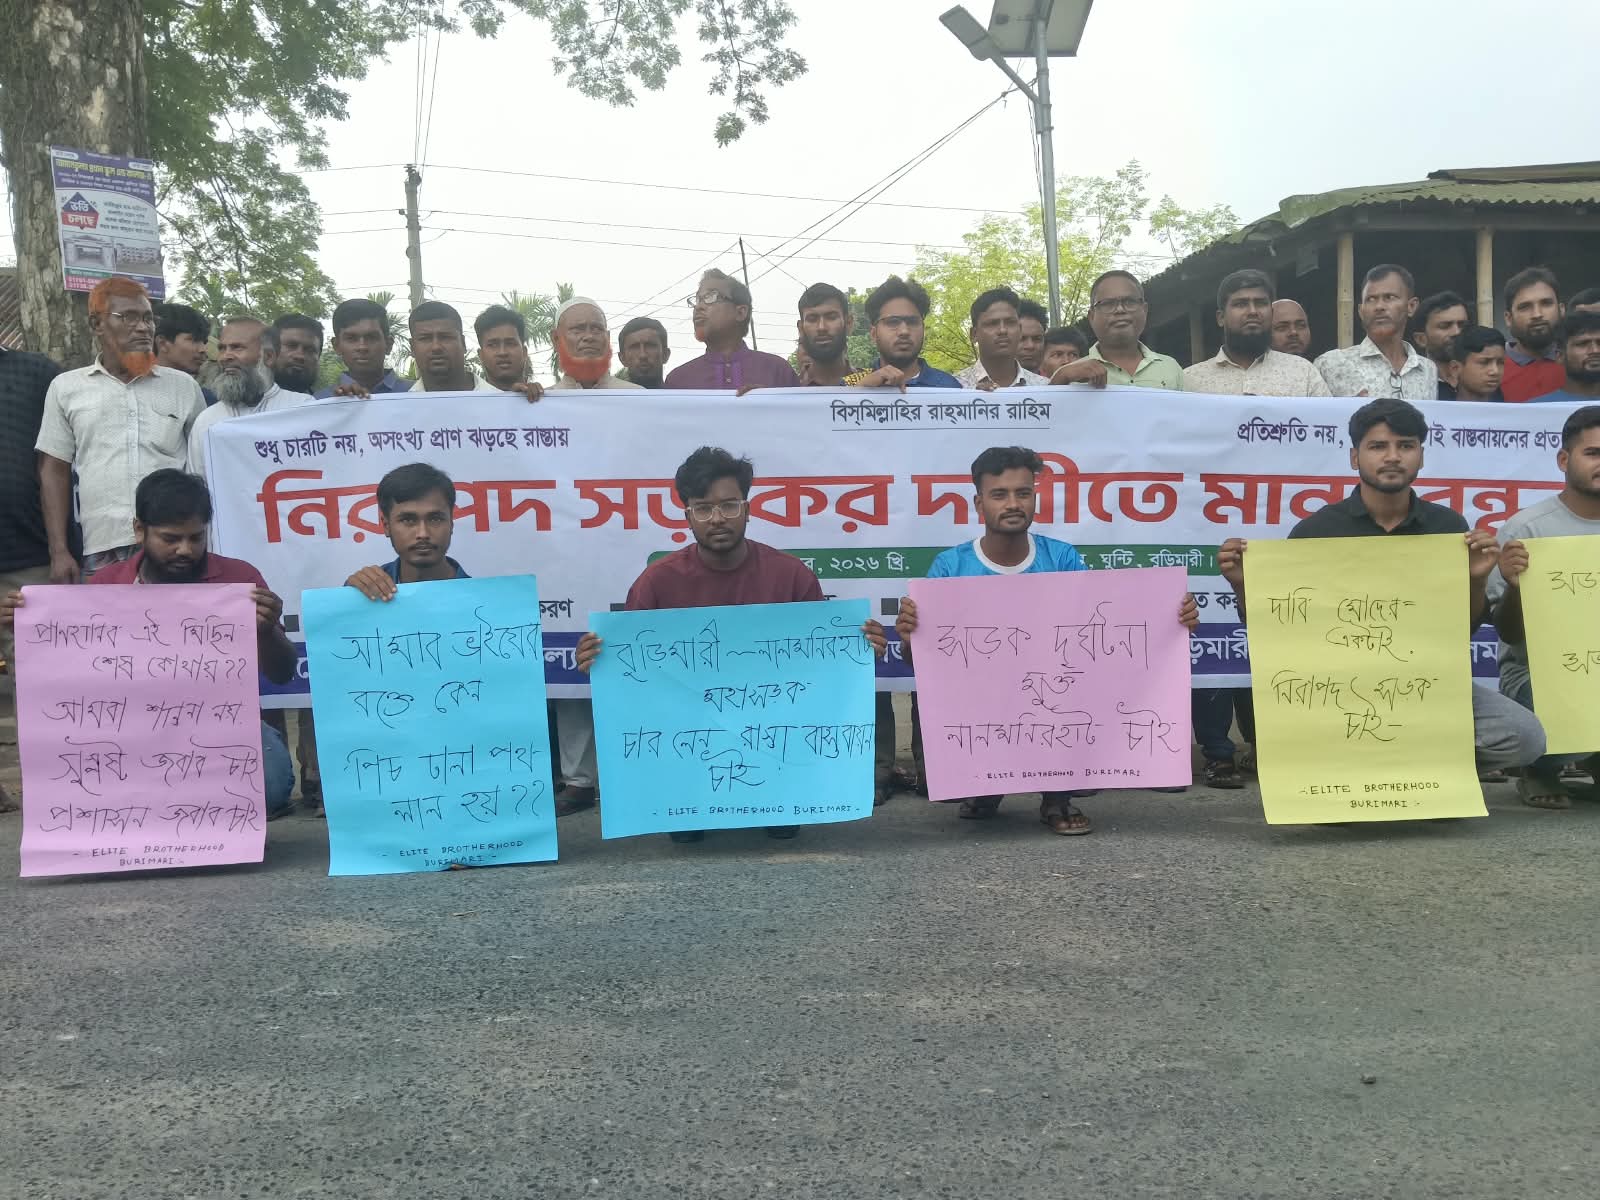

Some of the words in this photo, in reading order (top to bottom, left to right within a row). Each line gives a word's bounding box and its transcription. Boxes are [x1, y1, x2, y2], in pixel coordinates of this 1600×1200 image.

[67, 214, 95, 226] চলছে
[1006, 398, 1052, 423] রাহিম
[1237, 417, 1307, 445] প্রতিশ্রুতি
[1314, 425, 1344, 449] নয়,
[1451, 427, 1530, 449] বাস্তবায়নের
[254, 440, 283, 464] শুধু
[283, 430, 328, 458] চারটি
[332, 434, 364, 457] নয়,
[368, 431, 425, 452] অসংখ্য
[430, 427, 463, 451] প্রাণ
[467, 428, 519, 452] ঝড়ছে
[522, 427, 570, 449] রাস্তায়
[830, 557, 880, 574] ২০২৬
[1267, 587, 1317, 625] দাবি
[331, 628, 442, 675] আমার
[92, 654, 133, 680] শেষ
[622, 725, 662, 759] চার
[986, 771, 1015, 780] ELITE
[1085, 767, 1141, 778] BURIMARI
[1364, 781, 1440, 793] BROTHERHOOD
[668, 806, 698, 816] ELITE
[708, 805, 785, 816] BROTHERHOOD
[1349, 799, 1408, 809] BURIMARI
[92, 846, 129, 857] ELITE
[144, 843, 225, 855] BROTHERHOOD
[400, 847, 429, 857] ELITE
[442, 839, 524, 854] BROTHERHOOD
[119, 857, 174, 867] BURIMARI
